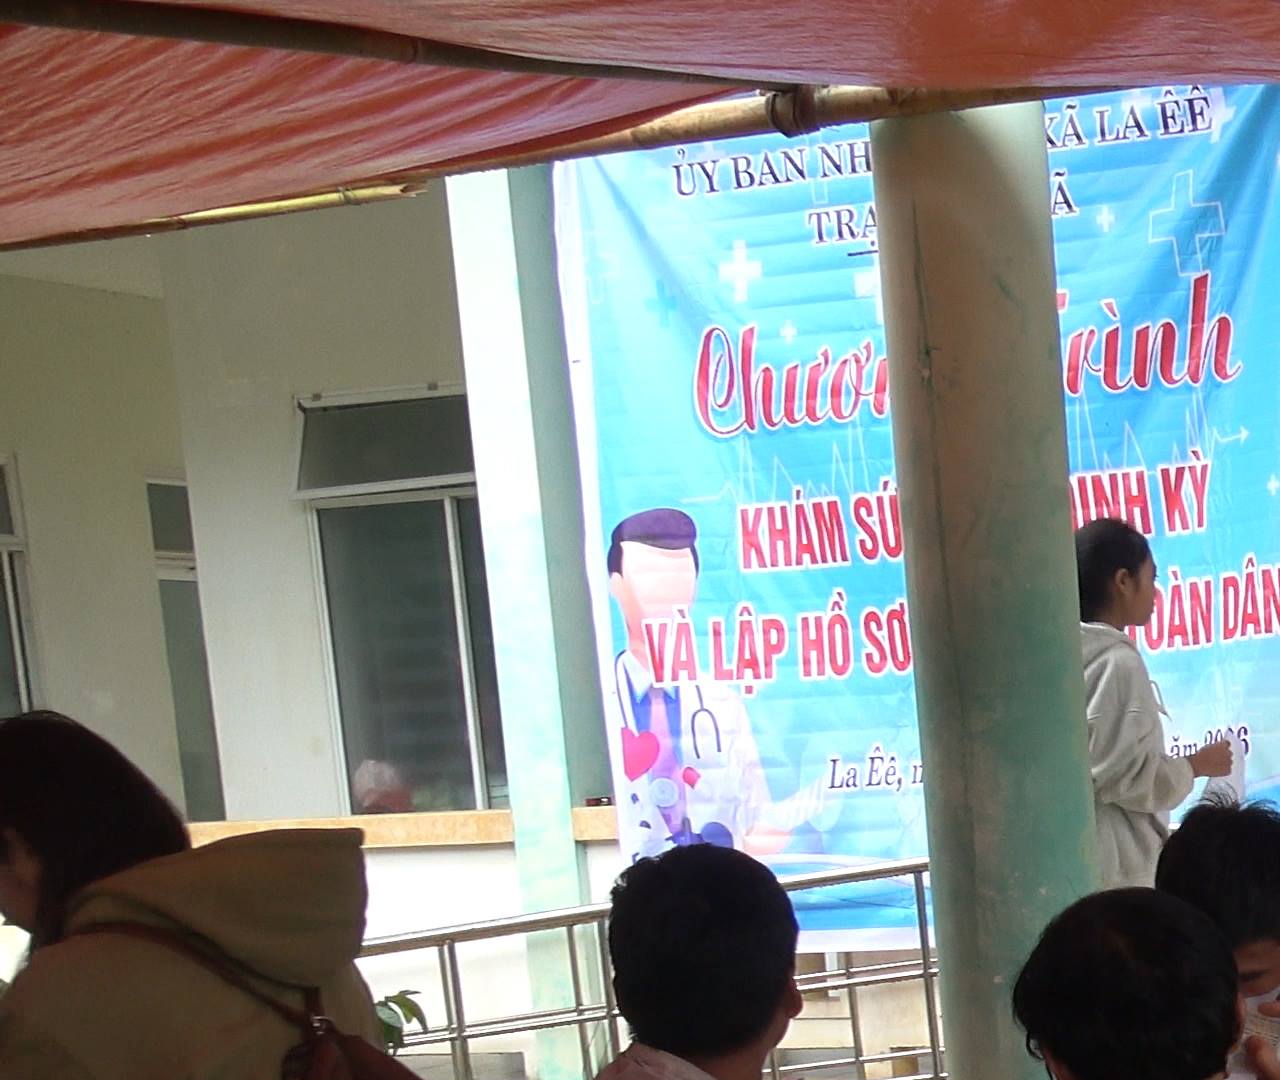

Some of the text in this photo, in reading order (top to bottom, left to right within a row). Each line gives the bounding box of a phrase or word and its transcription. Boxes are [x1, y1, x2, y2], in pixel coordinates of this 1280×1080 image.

[672, 147, 721, 196] ỦY
[730, 148, 807, 190] BAN
[818, 141, 873, 178] NH
[1096, 105, 1149, 143] LA
[1157, 85, 1213, 137] ÊÊ
[808, 171, 1077, 247] TRẠ Ã
[696, 272, 1242, 436] Chươ rình
[740, 489, 849, 569] KHÁM
[854, 480, 903, 561] SỨ
[1160, 449, 1209, 532] KỲ
[645, 609, 698, 683] VÀ
[712, 606, 789, 696] LẬP
[800, 591, 853, 677] HỒ
[862, 602, 912, 675] SƠ
[1128, 570, 1213, 651] OÀN
[828, 758, 858, 789] La
[865, 746, 903, 792] Êê,
[1171, 736, 1198, 757] ăm
